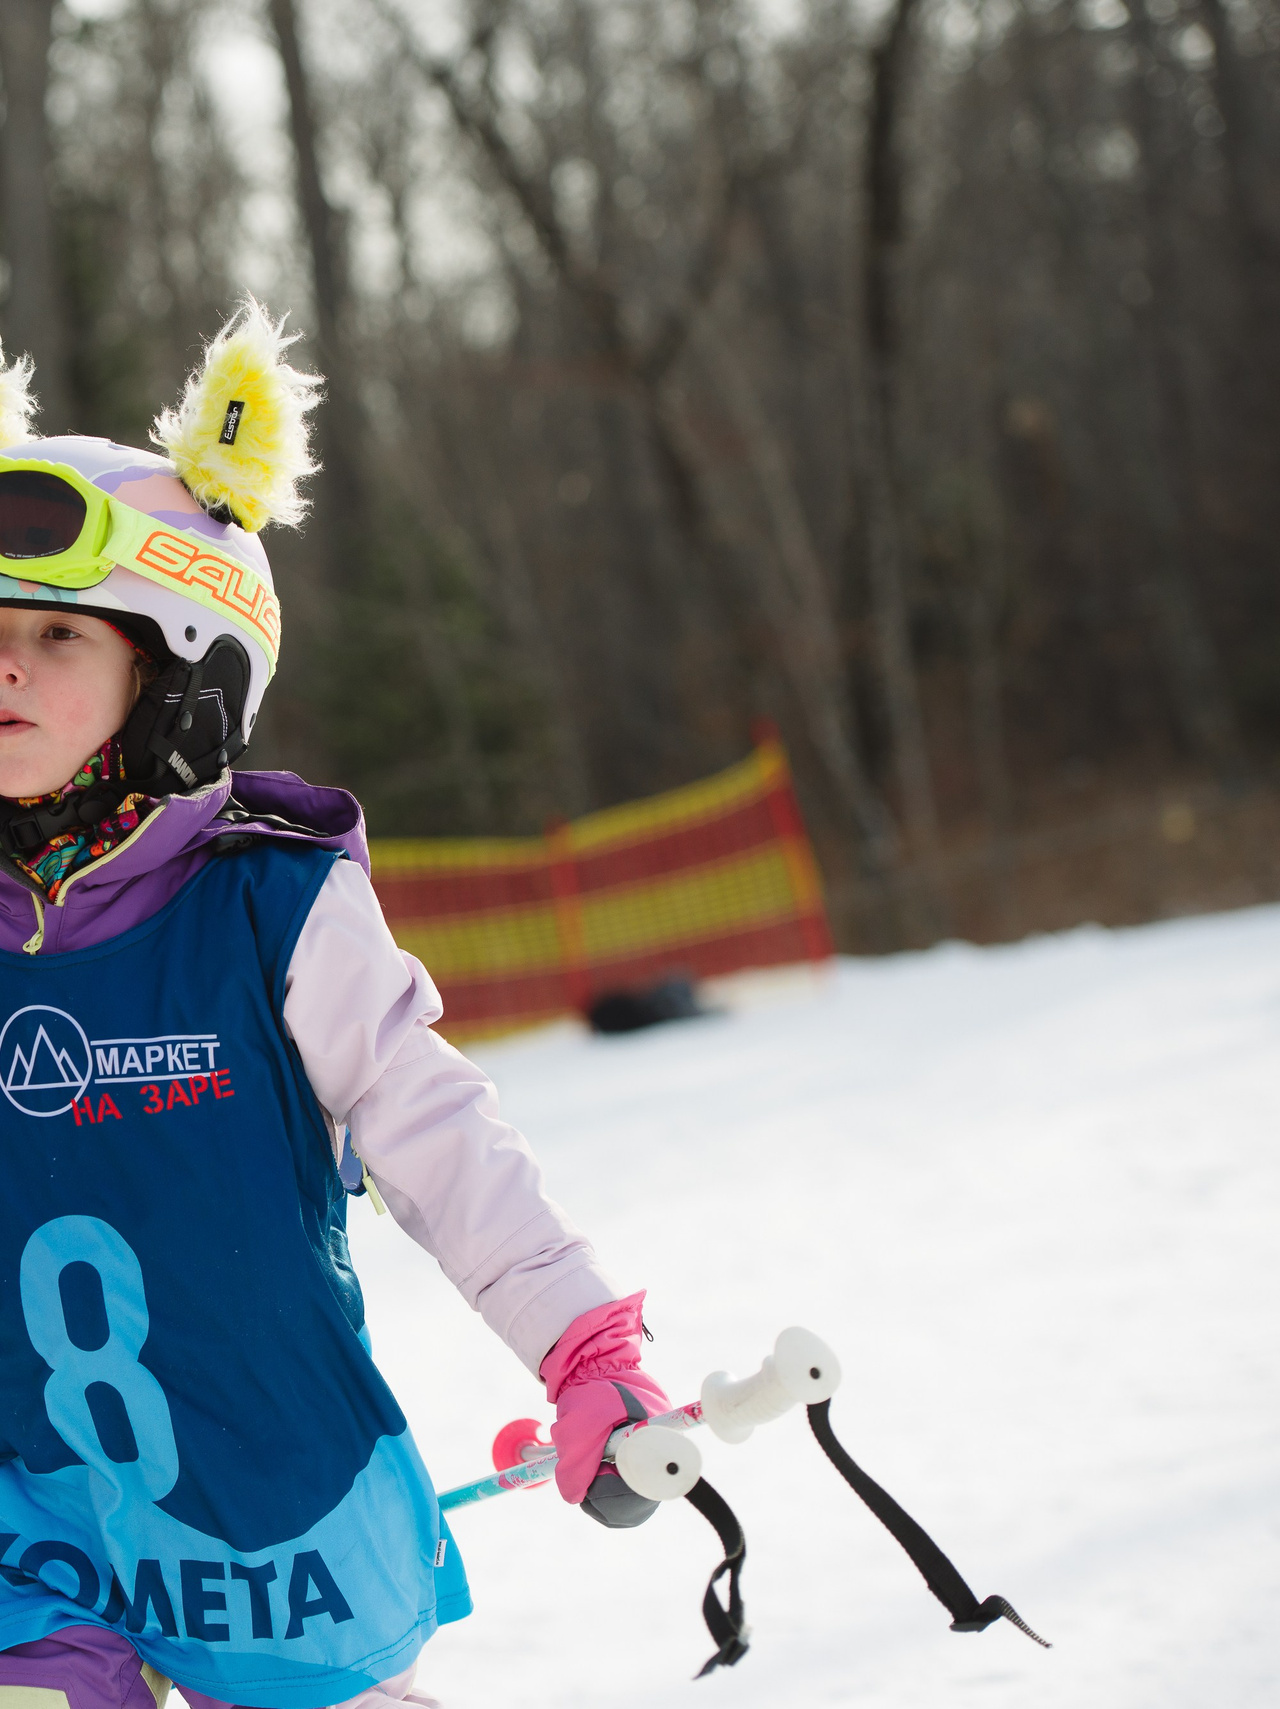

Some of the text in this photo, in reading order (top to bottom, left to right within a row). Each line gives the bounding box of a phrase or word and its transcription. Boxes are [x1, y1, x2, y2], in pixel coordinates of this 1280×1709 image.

[224, 406, 239, 440] Eisbär
[135, 530, 280, 658] SALIC
[95, 1041, 221, 1077] МАРКЕТ
[71, 1068, 236, 1127] НА ЗАРЕ
[20, 1214, 180, 1504] 8
